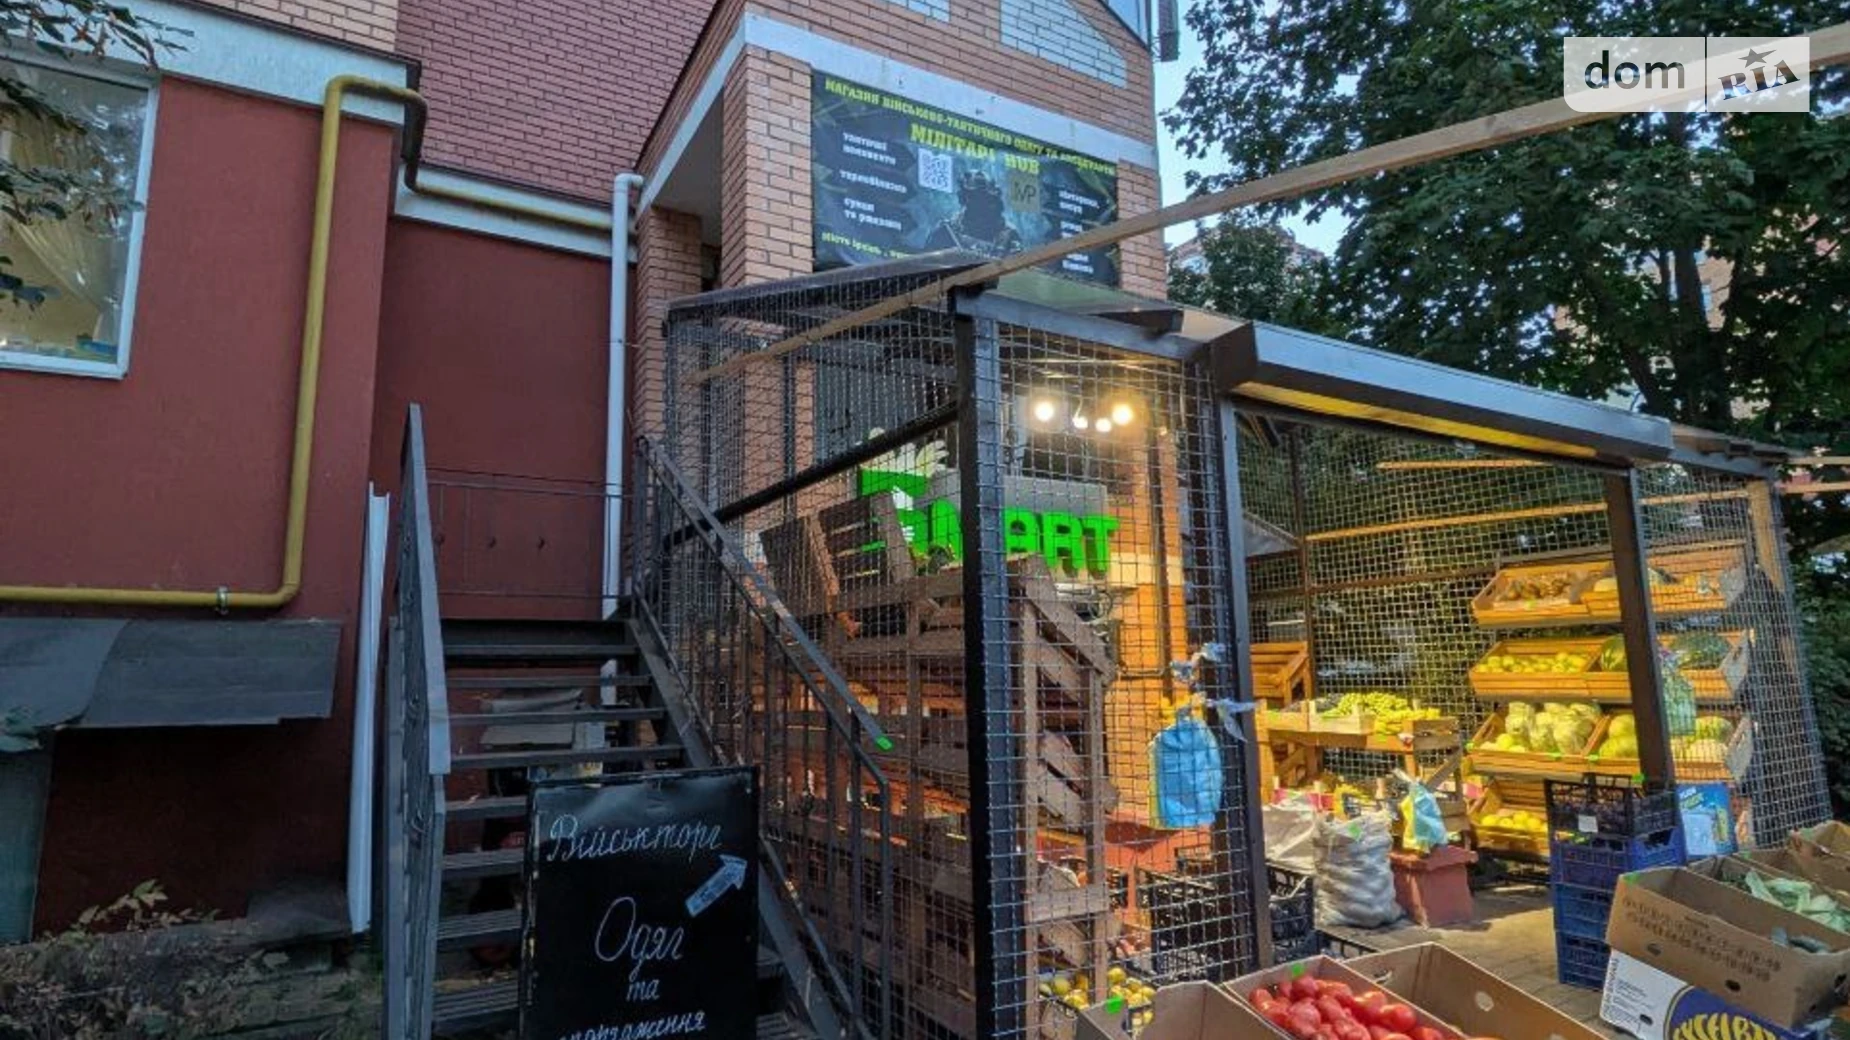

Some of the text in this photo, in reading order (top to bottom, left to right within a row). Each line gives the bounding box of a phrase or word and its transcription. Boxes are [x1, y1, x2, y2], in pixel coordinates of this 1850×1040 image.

[825, 77, 879, 105] МАГАЗИН
[546, 813, 722, 862] Військторг
[595, 896, 684, 981] Одяг
[627, 979, 660, 1002] та
